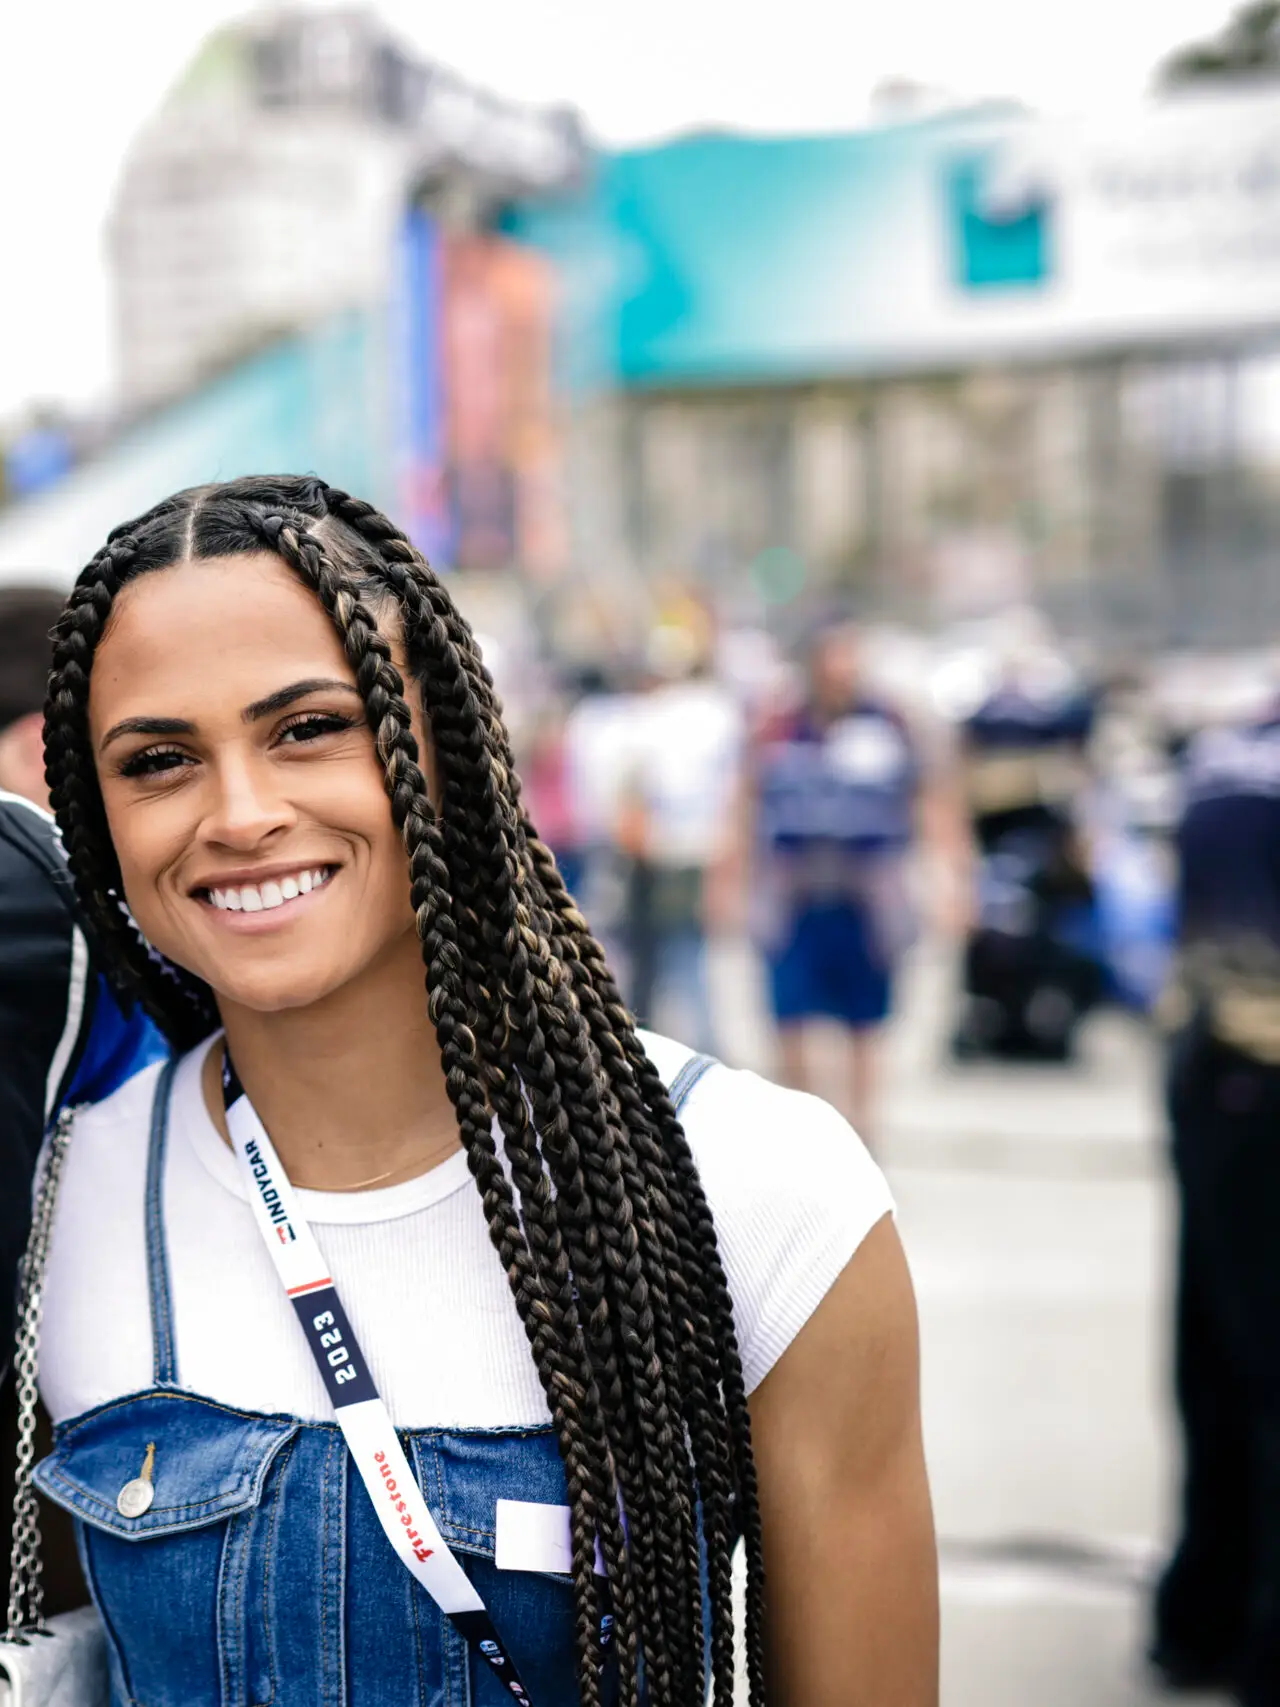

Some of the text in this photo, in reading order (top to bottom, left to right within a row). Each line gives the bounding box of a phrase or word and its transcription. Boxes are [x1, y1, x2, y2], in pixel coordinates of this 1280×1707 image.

[245, 1137, 287, 1224] INDYCAR
[313, 1310, 357, 1385] 2023
[374, 1450, 434, 1563] Firestone
